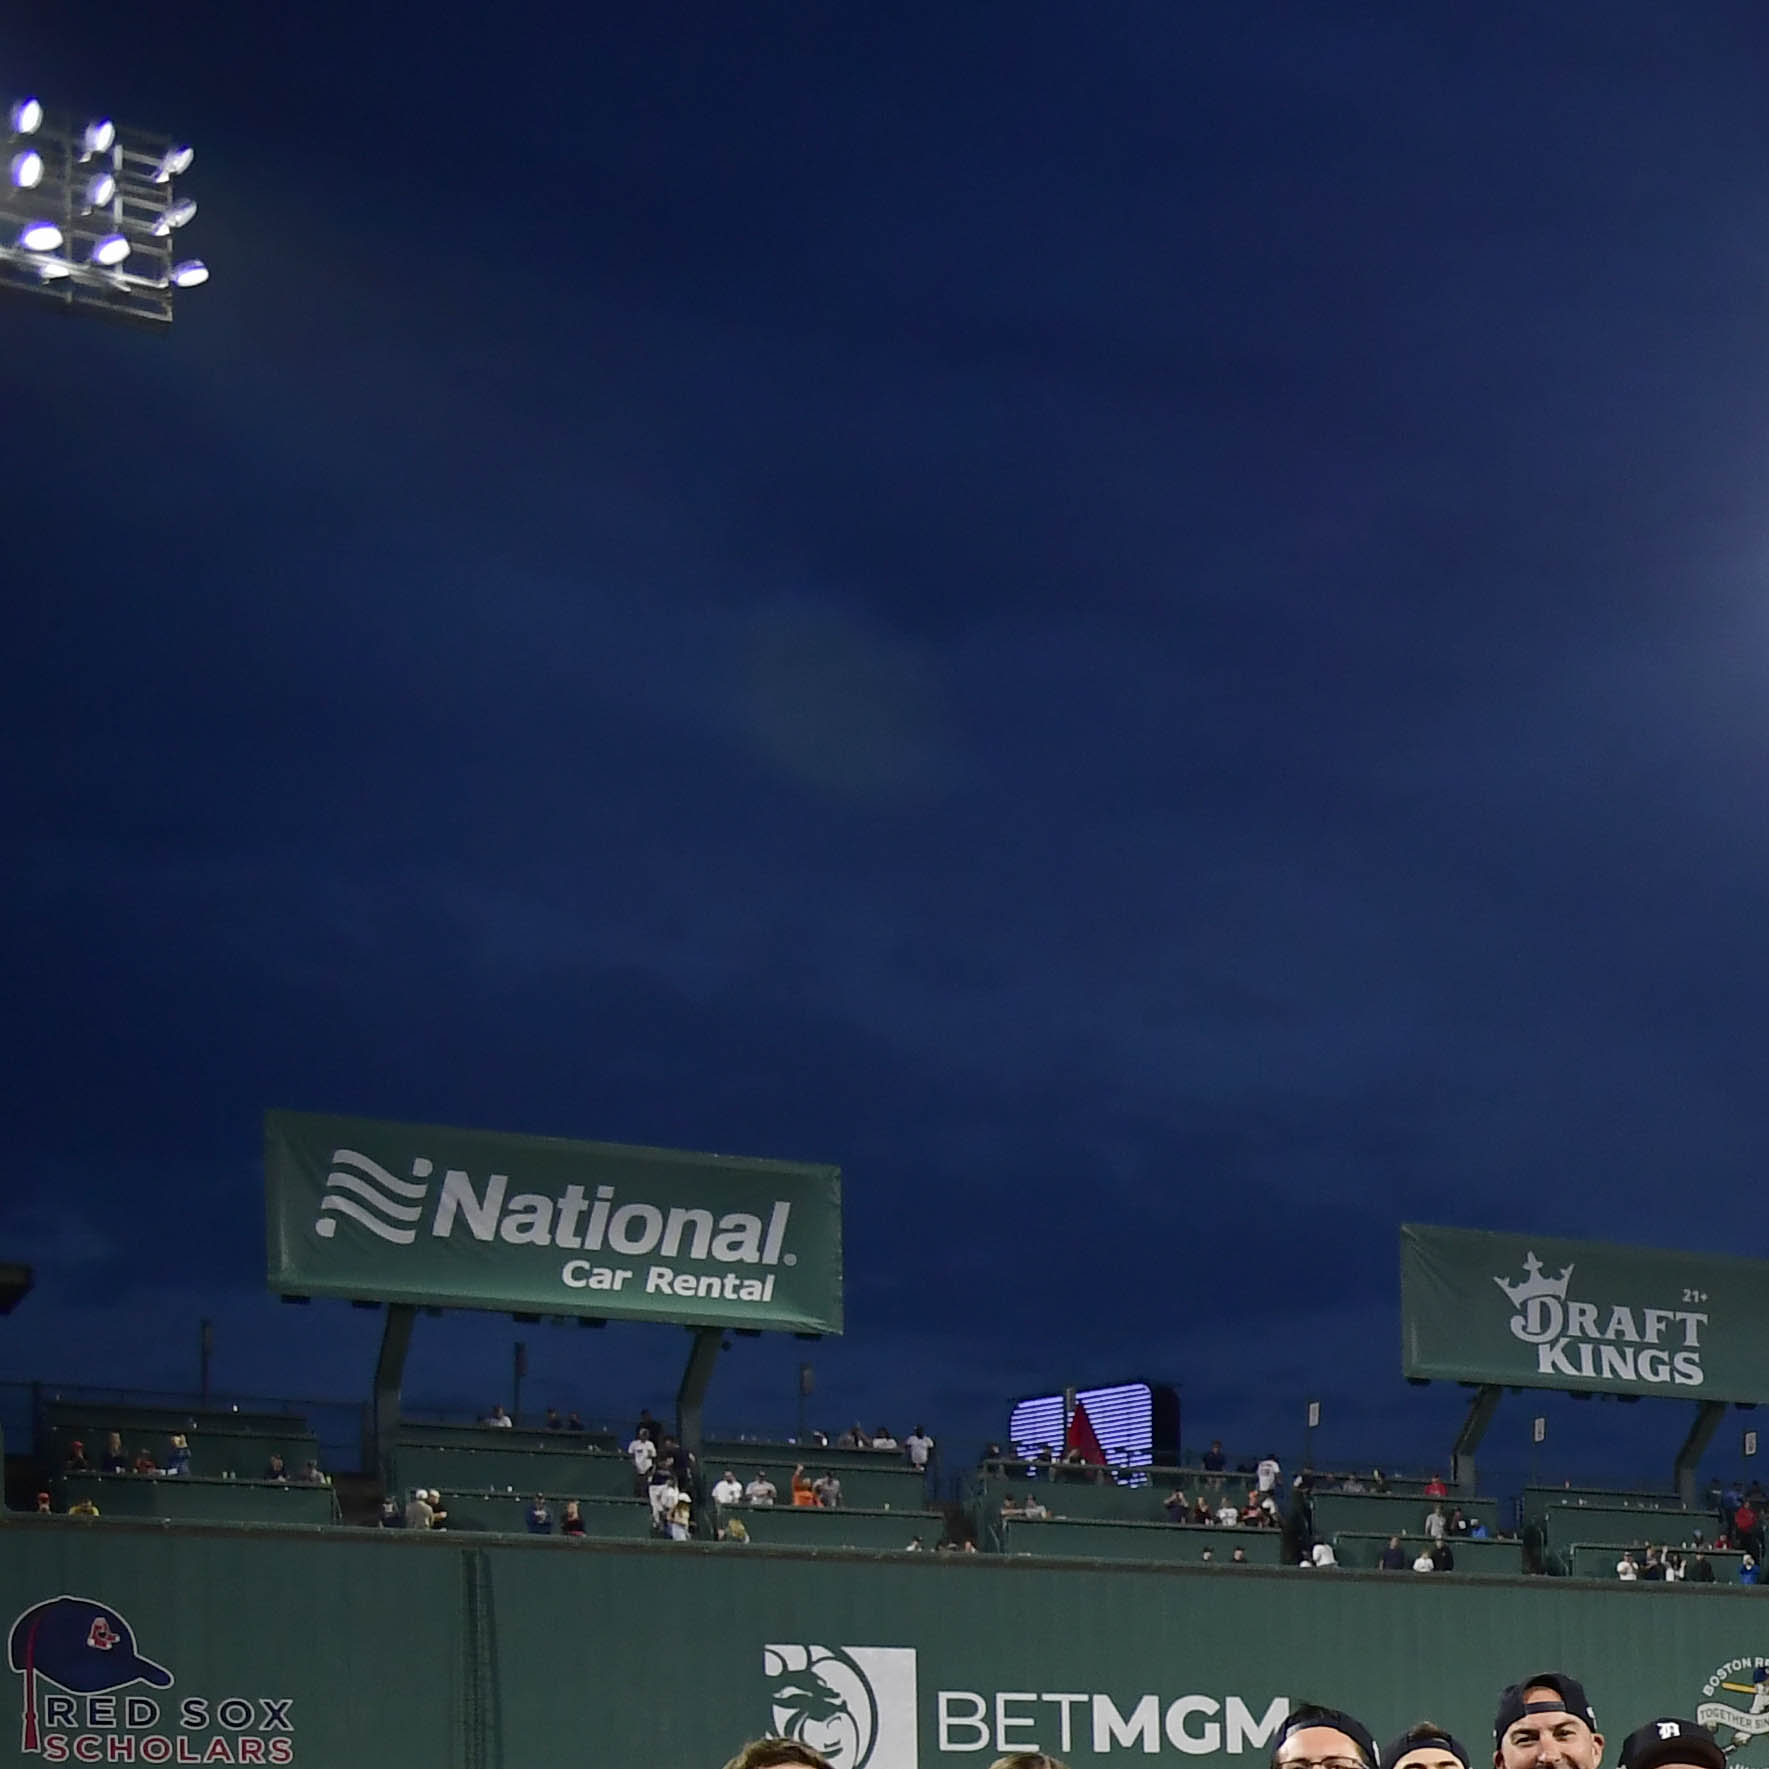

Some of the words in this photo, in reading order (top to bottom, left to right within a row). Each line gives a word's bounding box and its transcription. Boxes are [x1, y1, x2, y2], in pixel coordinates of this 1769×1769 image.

[432, 1168, 790, 1266] National
[561, 1259, 632, 1292] Car
[645, 1265, 776, 1303] Rental
[1682, 1288, 1708, 1304] 21+
[1508, 1294, 1710, 1348] DRAFT
[1536, 1341, 1706, 1387] KINGS
[1702, 1657, 1752, 1697] BOSTON
[43, 1694, 161, 1730] RED
[179, 1697, 295, 1732] SOX
[937, 1689, 1290, 1756] BETMGM
[1699, 1707, 1752, 1729] TOGETHER
[42, 1733, 295, 1765] SCHOLARS
